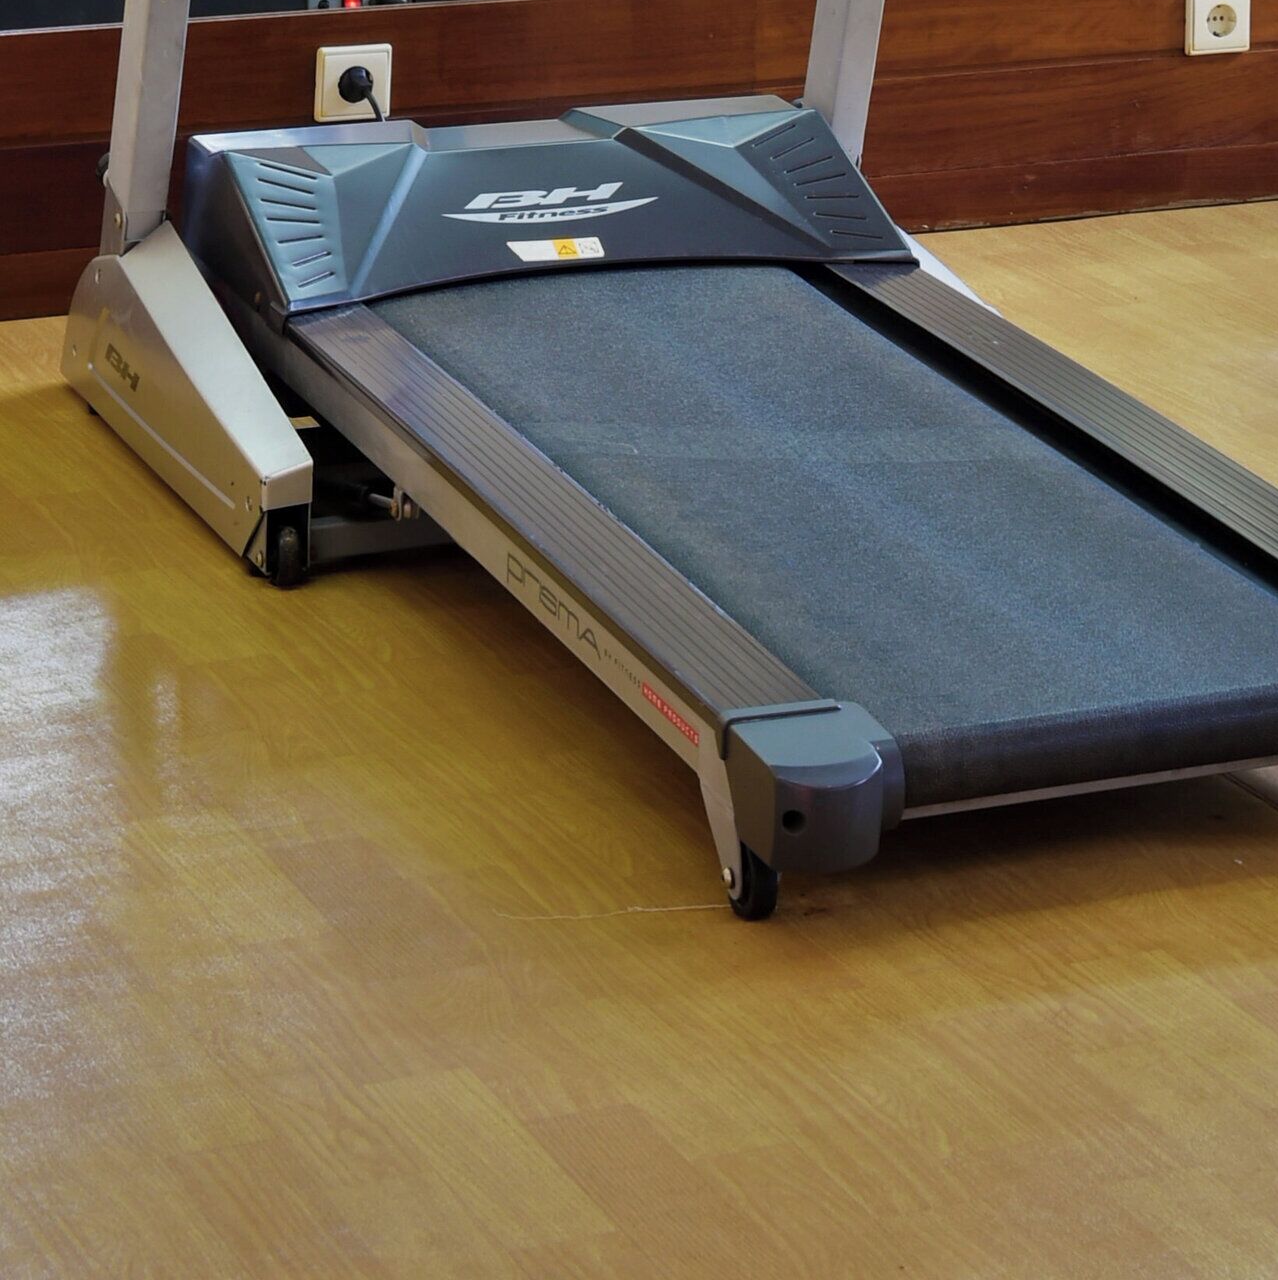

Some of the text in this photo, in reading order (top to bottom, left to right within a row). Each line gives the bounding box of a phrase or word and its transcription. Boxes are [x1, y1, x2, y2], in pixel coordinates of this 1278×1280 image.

[464, 181, 623, 210] BH
[498, 206, 608, 221] Fitness
[105, 342, 140, 392] BH
